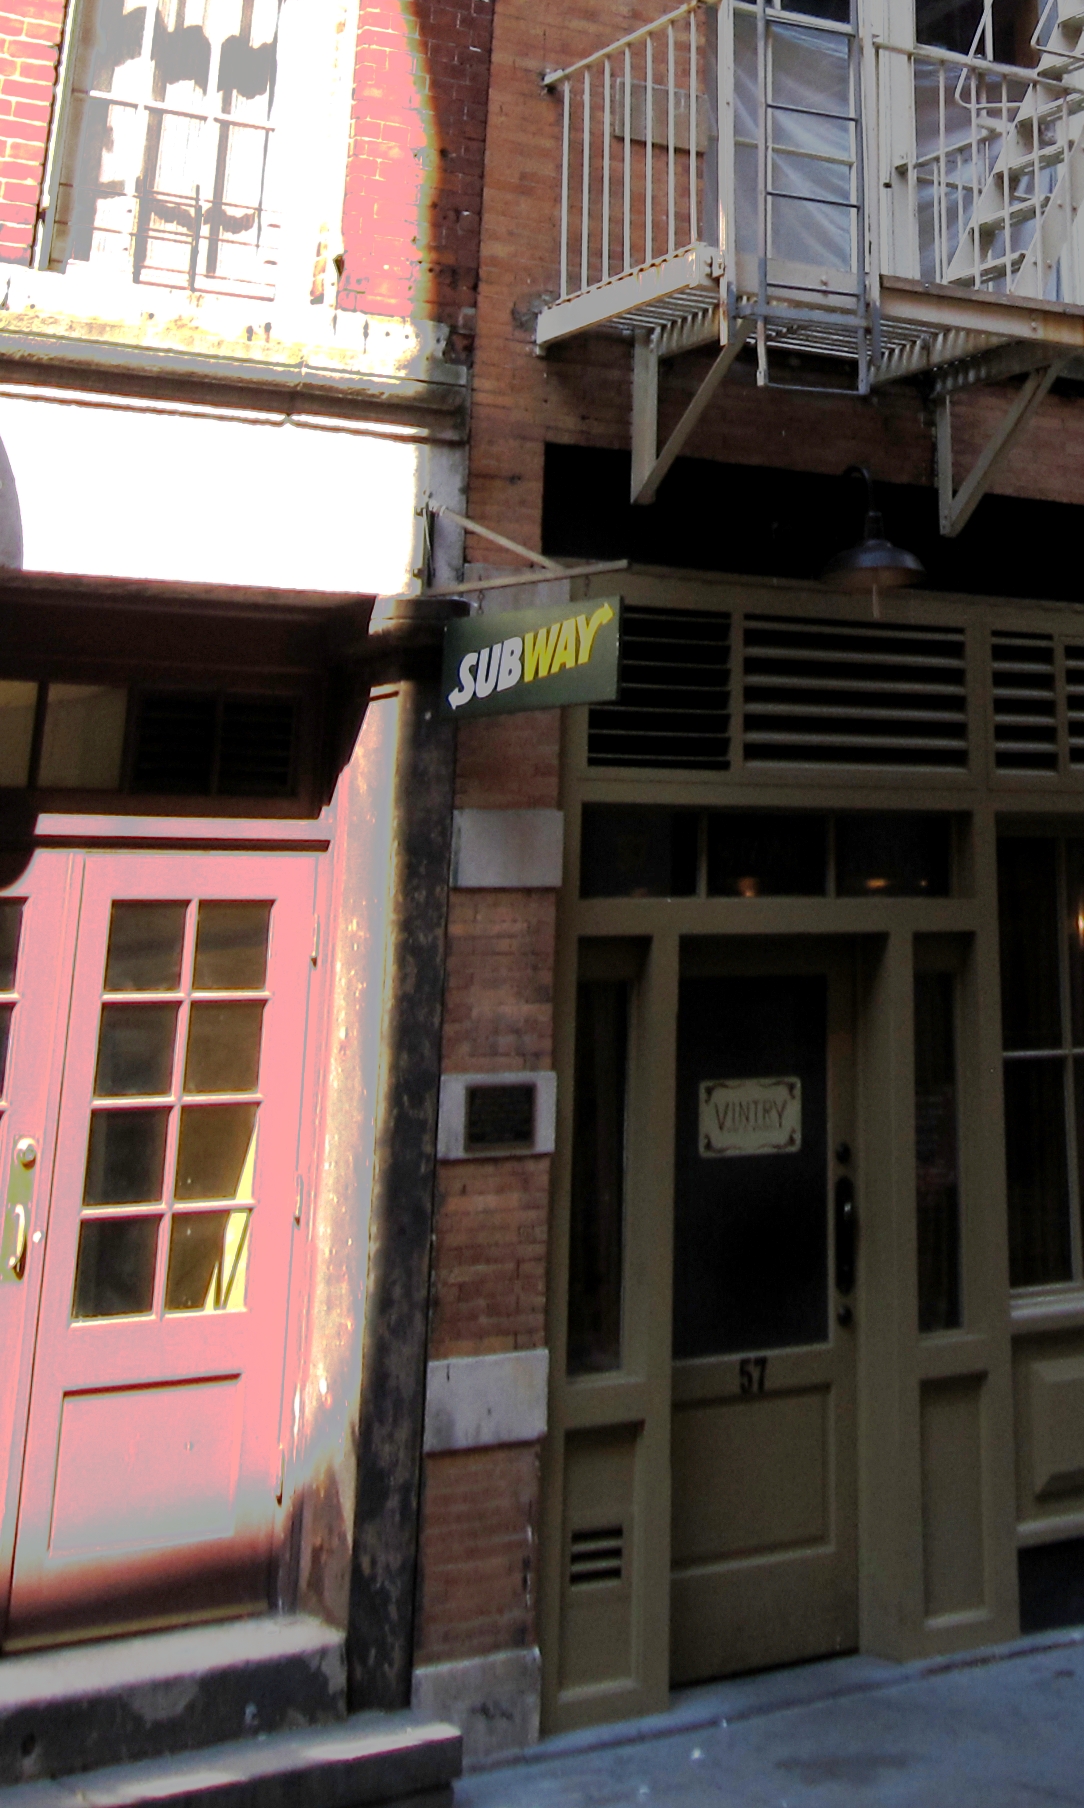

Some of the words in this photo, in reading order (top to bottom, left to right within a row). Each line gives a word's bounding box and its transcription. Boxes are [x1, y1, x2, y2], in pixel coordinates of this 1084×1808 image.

[448, 602, 615, 710] SUBWAY
[713, 1099, 788, 1132] VINTRY
[739, 1356, 767, 1395] 57
